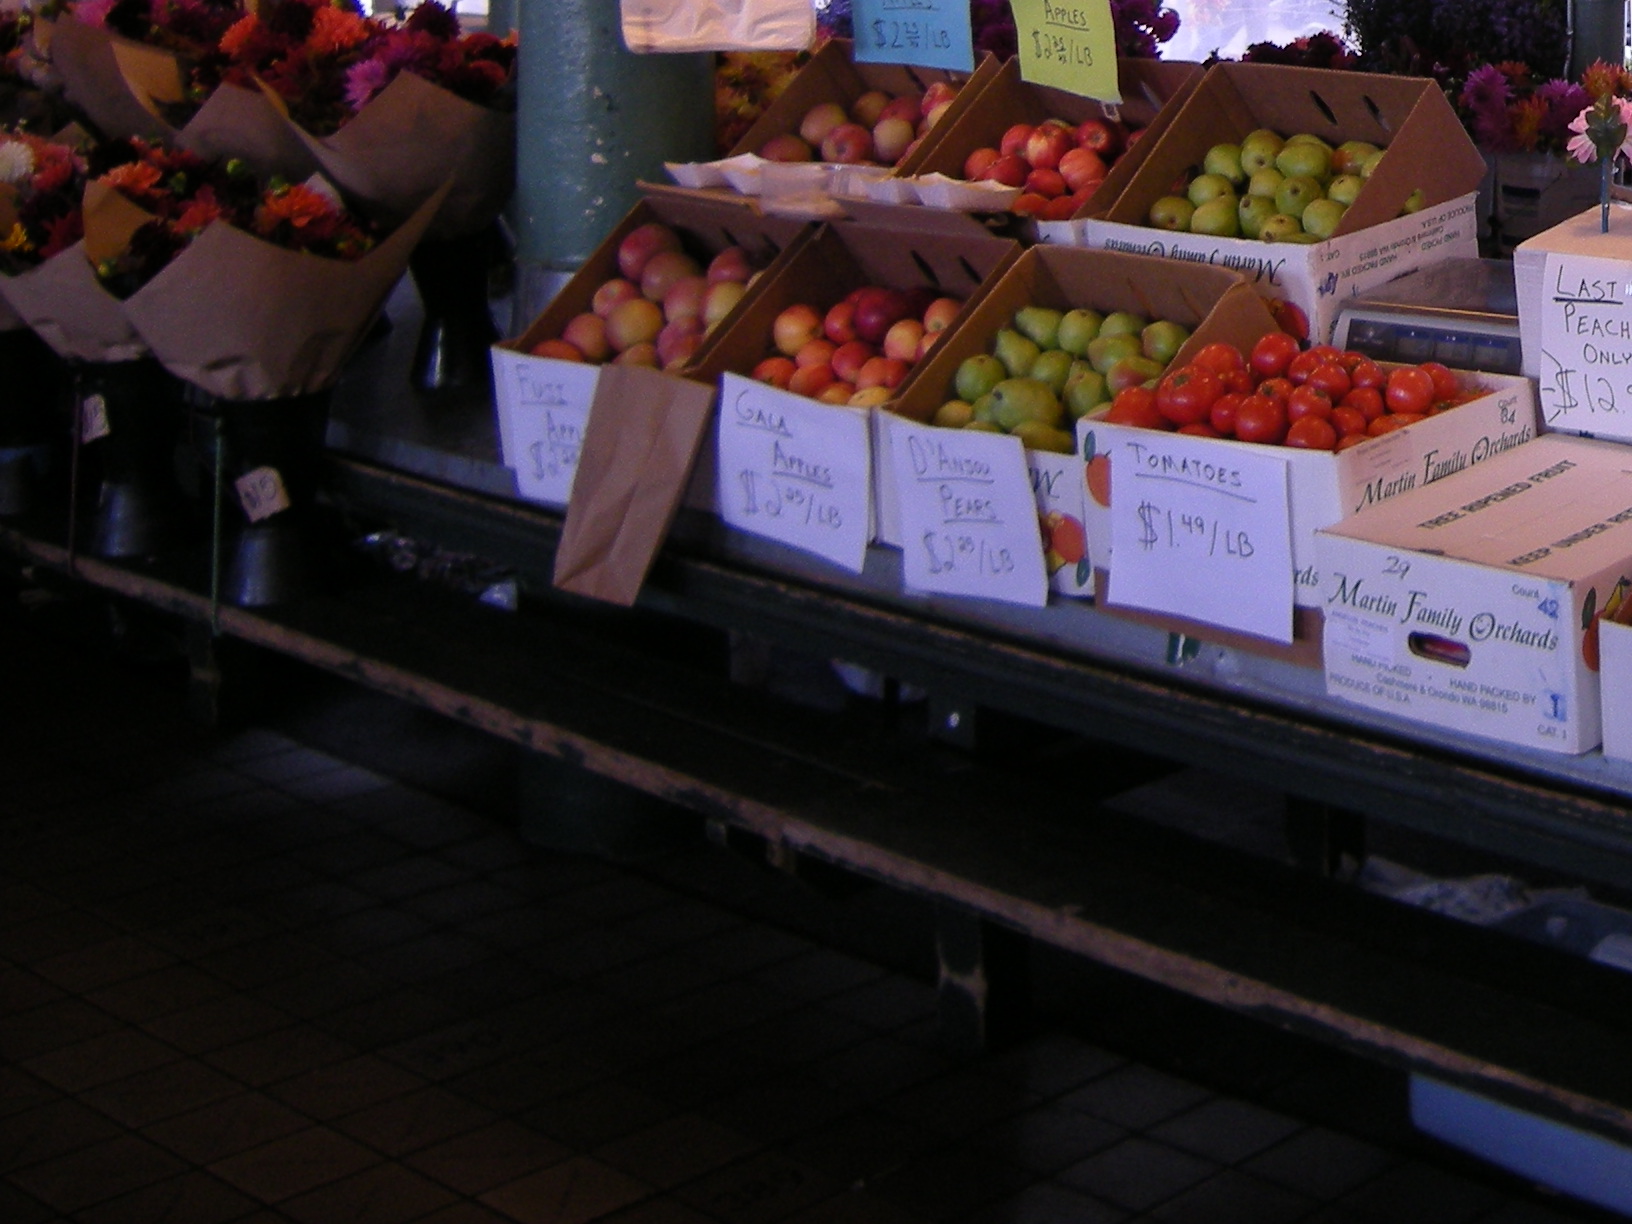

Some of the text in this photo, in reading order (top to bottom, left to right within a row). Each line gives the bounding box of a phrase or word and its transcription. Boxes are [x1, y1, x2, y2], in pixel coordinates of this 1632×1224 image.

[1556, 264, 1617, 298] LAST
[736, 389, 791, 435] GALA
[1126, 440, 1242, 487] TOMATOES
[1354, 470, 1416, 514] Martin
[1422, 449, 1468, 486] Family
[1471, 424, 1531, 466] Orchards
[940, 484, 996, 520] PEARS
[1511, 583, 1539, 599] Count
[1328, 572, 1398, 617] Martin
[1400, 590, 1463, 636] Family
[1469, 612, 1558, 652] Orchards
[1450, 678, 1478, 692] HAND
[1480, 684, 1520, 702] PACKED
[1522, 693, 1536, 705] BY
